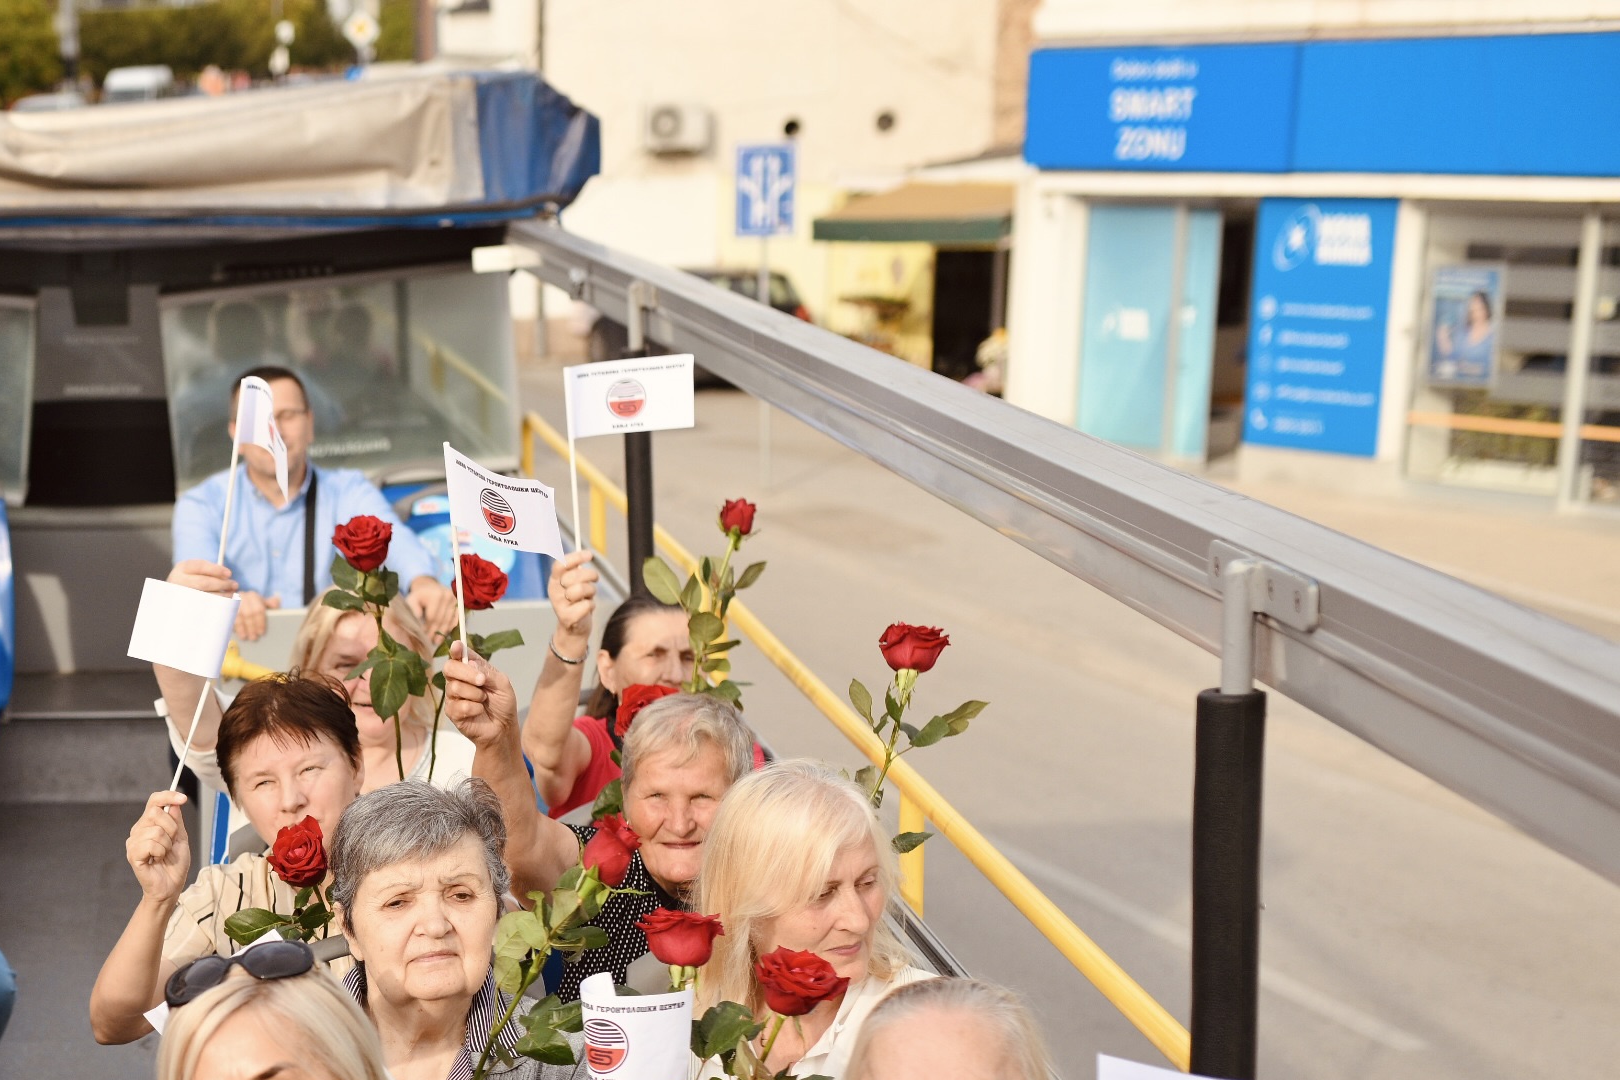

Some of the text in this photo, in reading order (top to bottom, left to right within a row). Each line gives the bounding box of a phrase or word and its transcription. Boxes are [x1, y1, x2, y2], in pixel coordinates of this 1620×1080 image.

[1110, 87, 1197, 121] SMART
[1115, 126, 1187, 160] ZONU
[596, 1005, 657, 1014] ГЕРОНТОЛОШКИ
[659, 1001, 685, 1011] ЦЕНТАР
